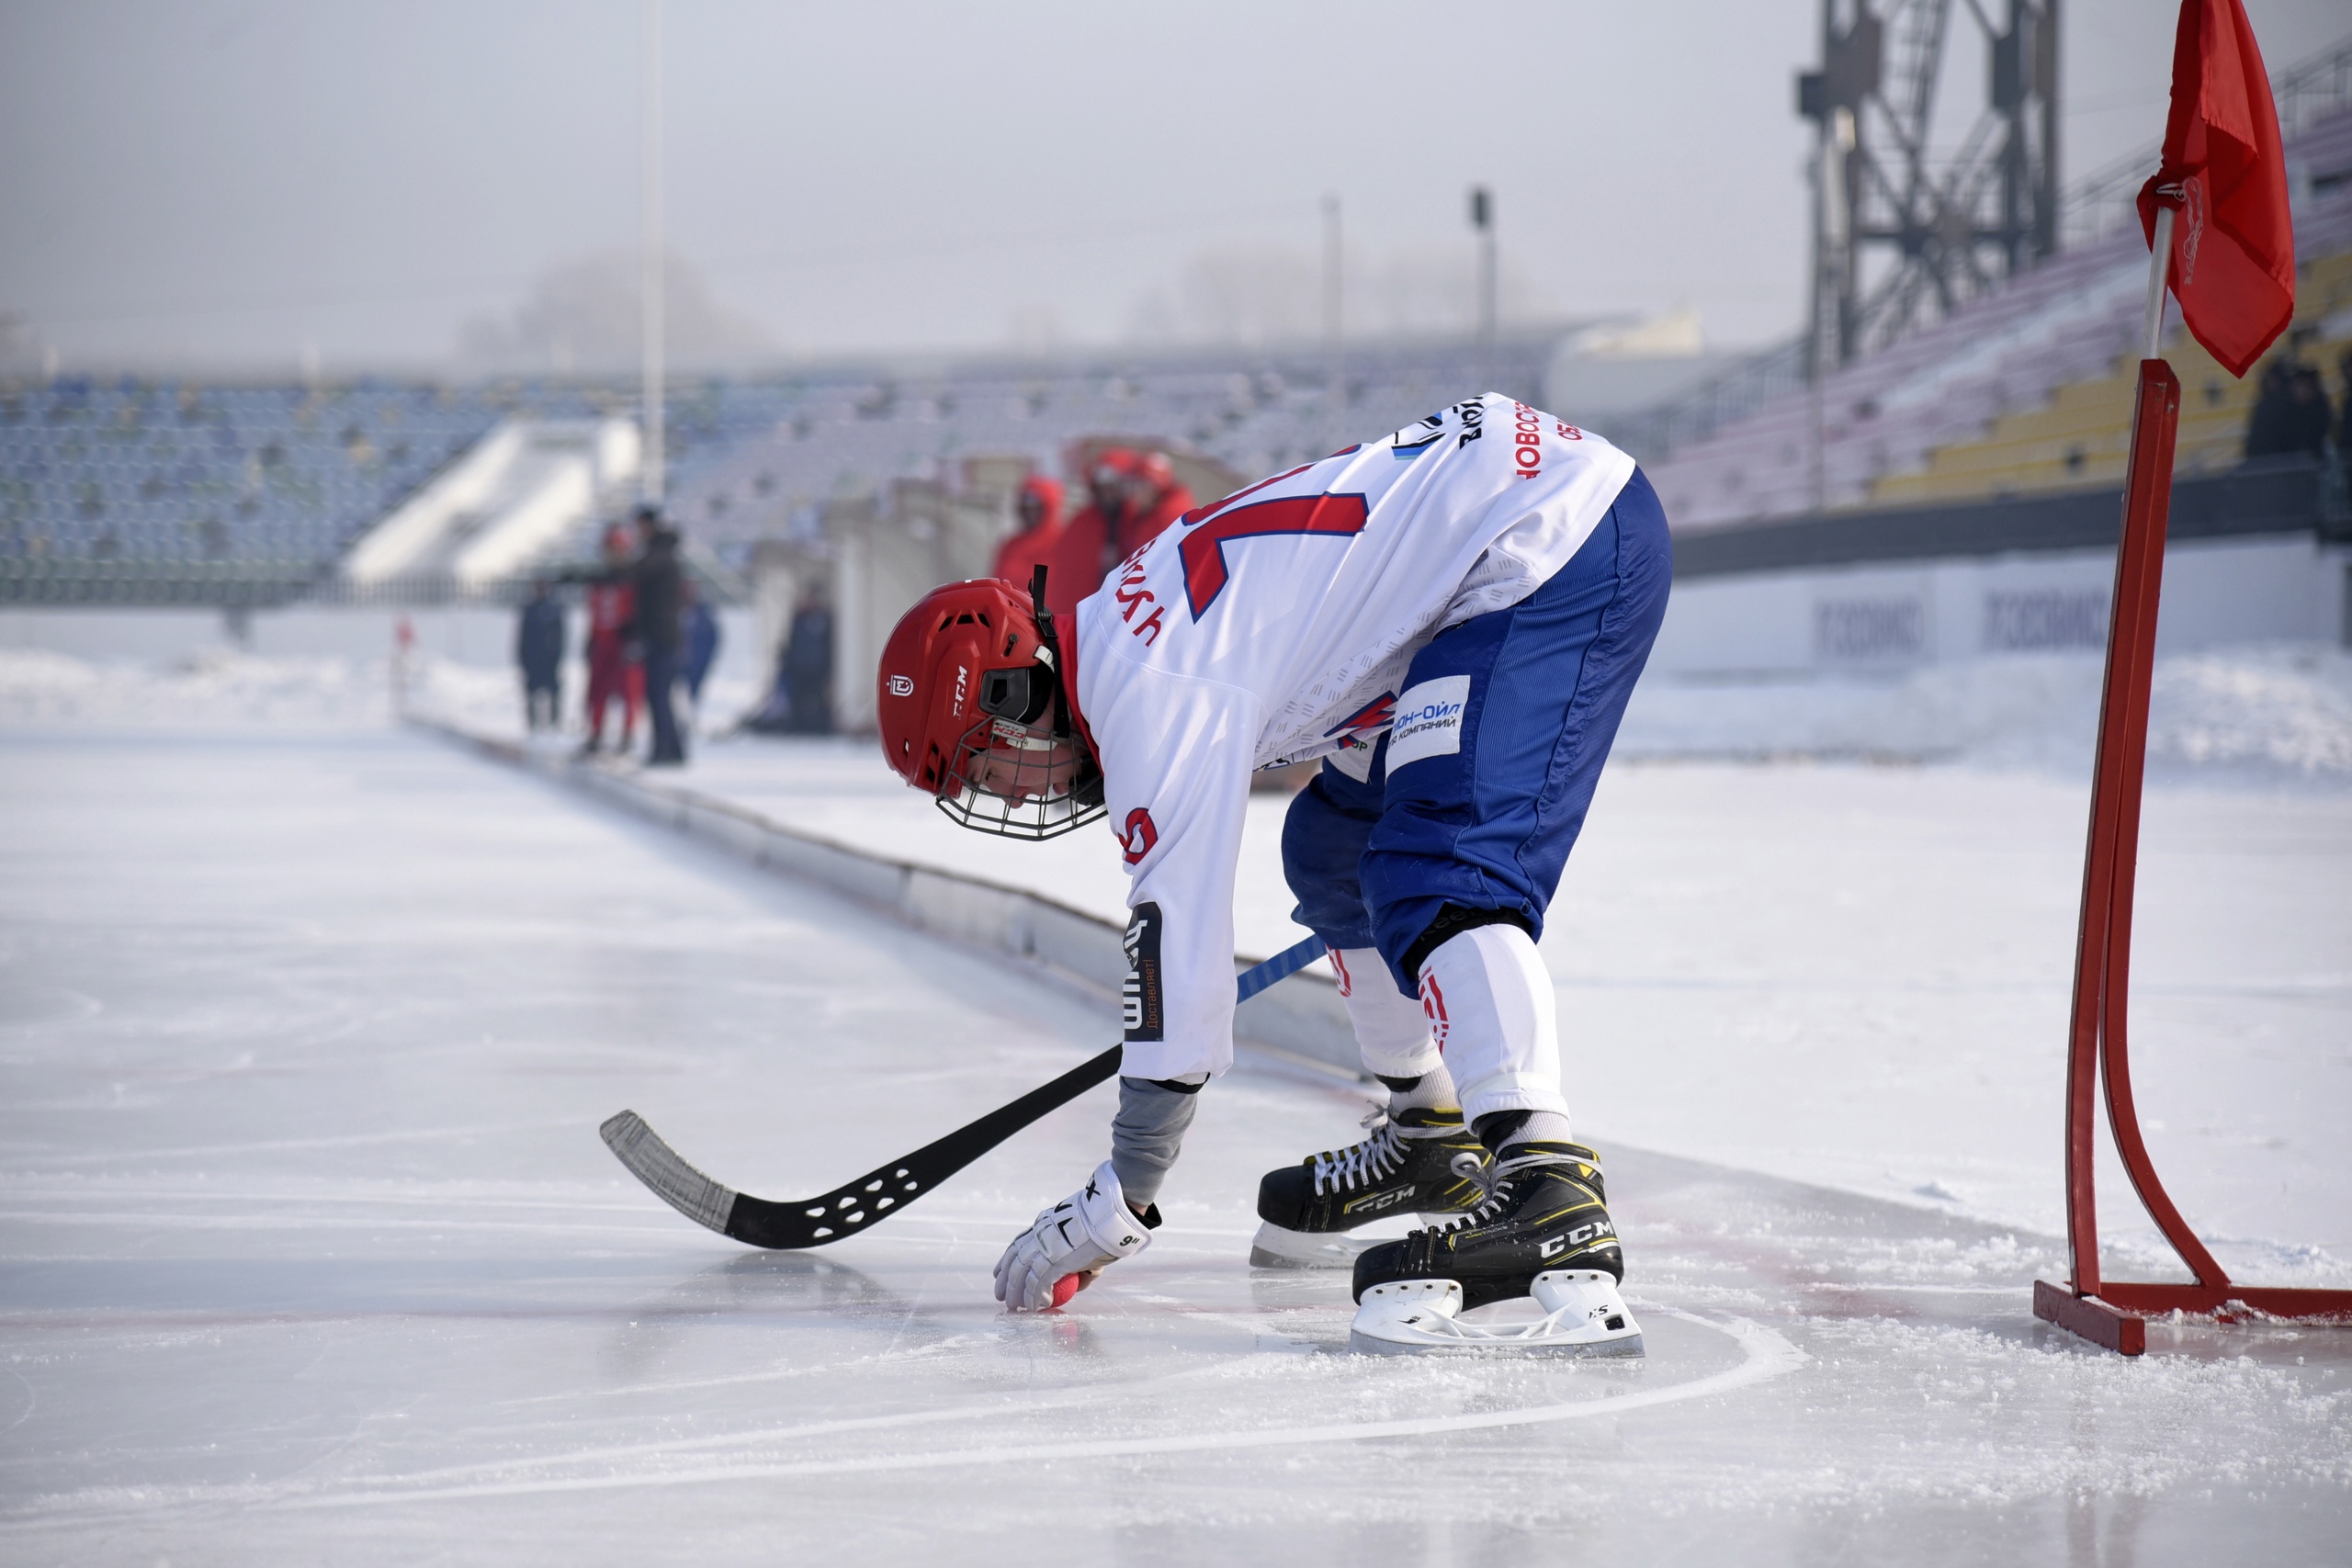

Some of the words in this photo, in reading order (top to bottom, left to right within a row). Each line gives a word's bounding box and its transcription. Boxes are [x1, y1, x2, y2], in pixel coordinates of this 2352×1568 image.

[1398, 716, 1456, 740] КОМПАНИЙ
[1143, 959, 1159, 1030] Доставляет!
[1539, 1221, 1614, 1258] CCM
